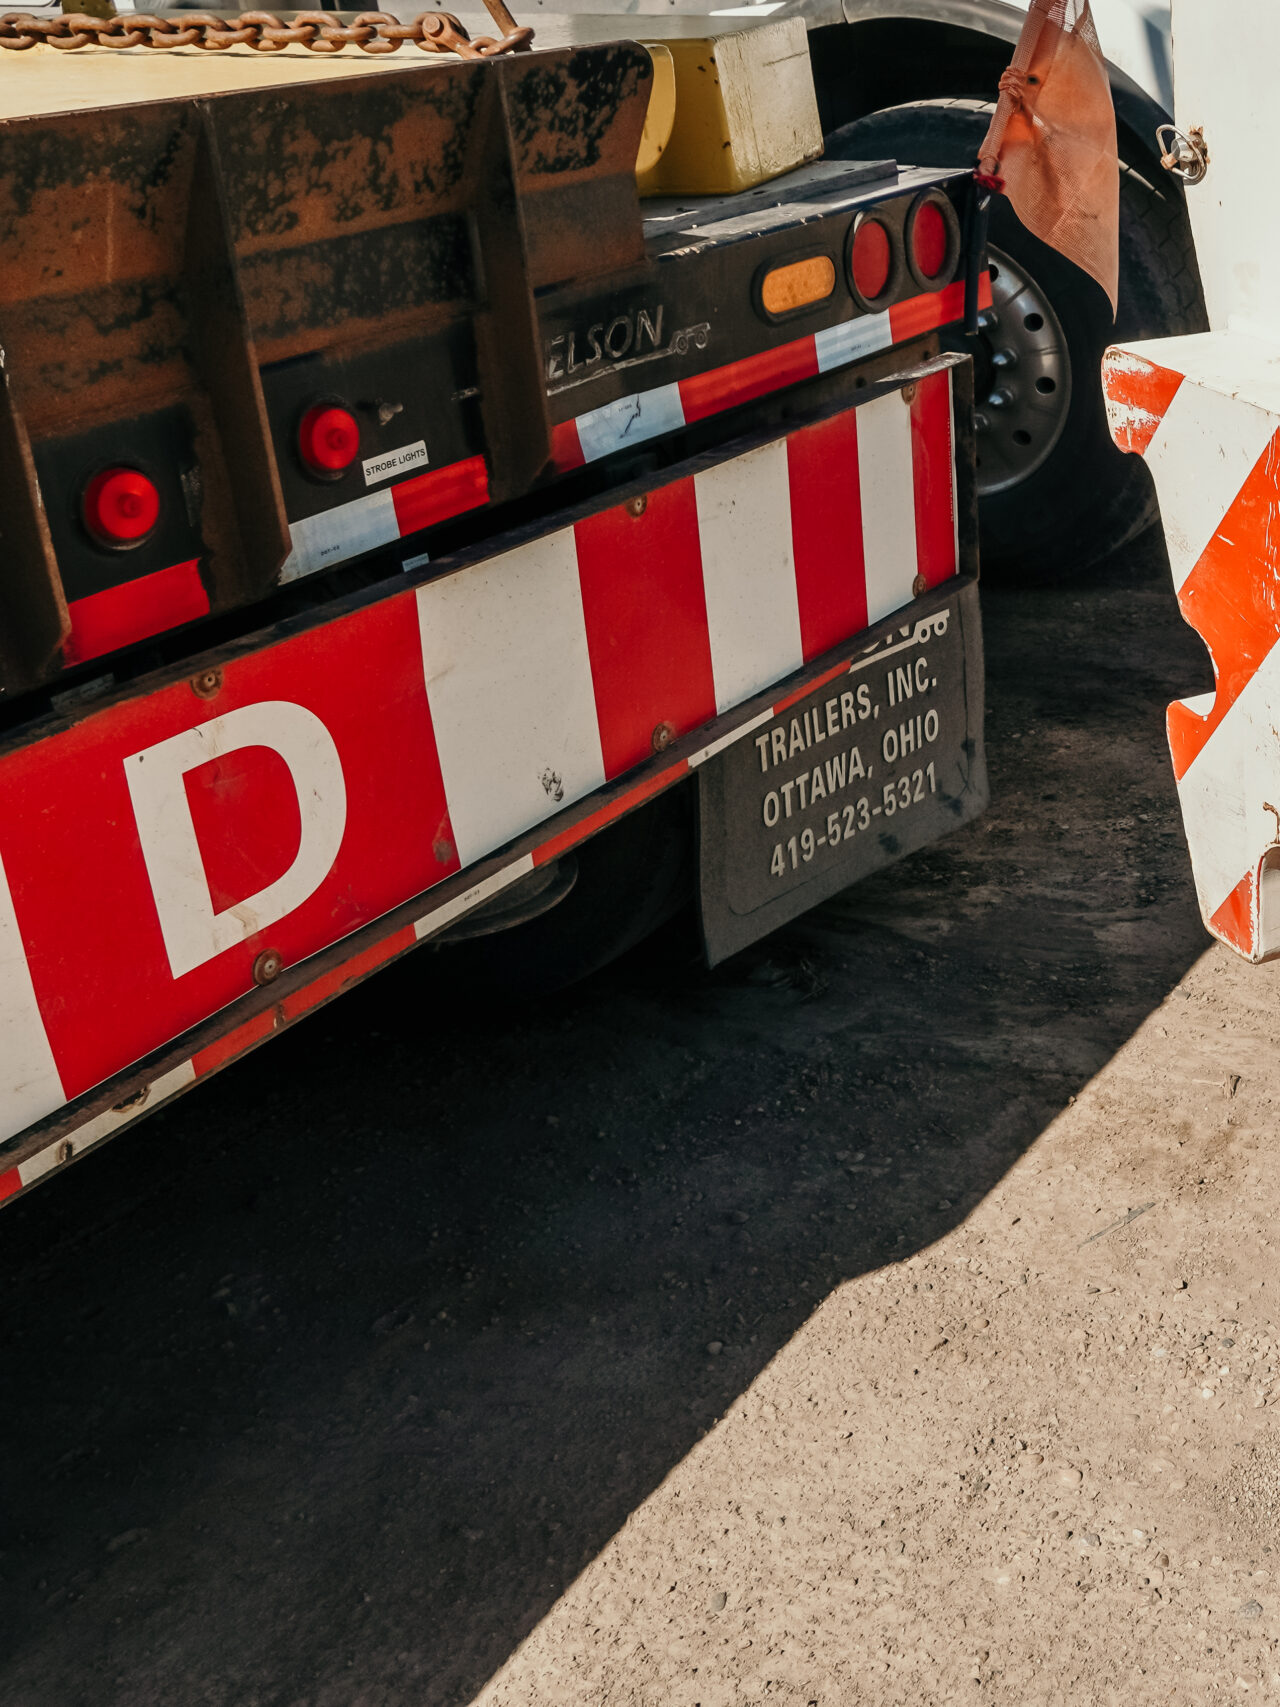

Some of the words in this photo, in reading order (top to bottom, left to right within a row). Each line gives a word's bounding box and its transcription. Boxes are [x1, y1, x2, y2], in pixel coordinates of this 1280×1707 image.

[548, 305, 663, 378] ELSON
[365, 458, 398, 476] STROBE
[398, 448, 426, 465] LIGHTS
[755, 683, 879, 774] TRAILERS,
[887, 657, 938, 706] INC.
[763, 746, 873, 828] OTTAWA,
[883, 709, 939, 763] OHIO
[123, 701, 347, 979] D
[770, 761, 937, 877] 419-523-5321
